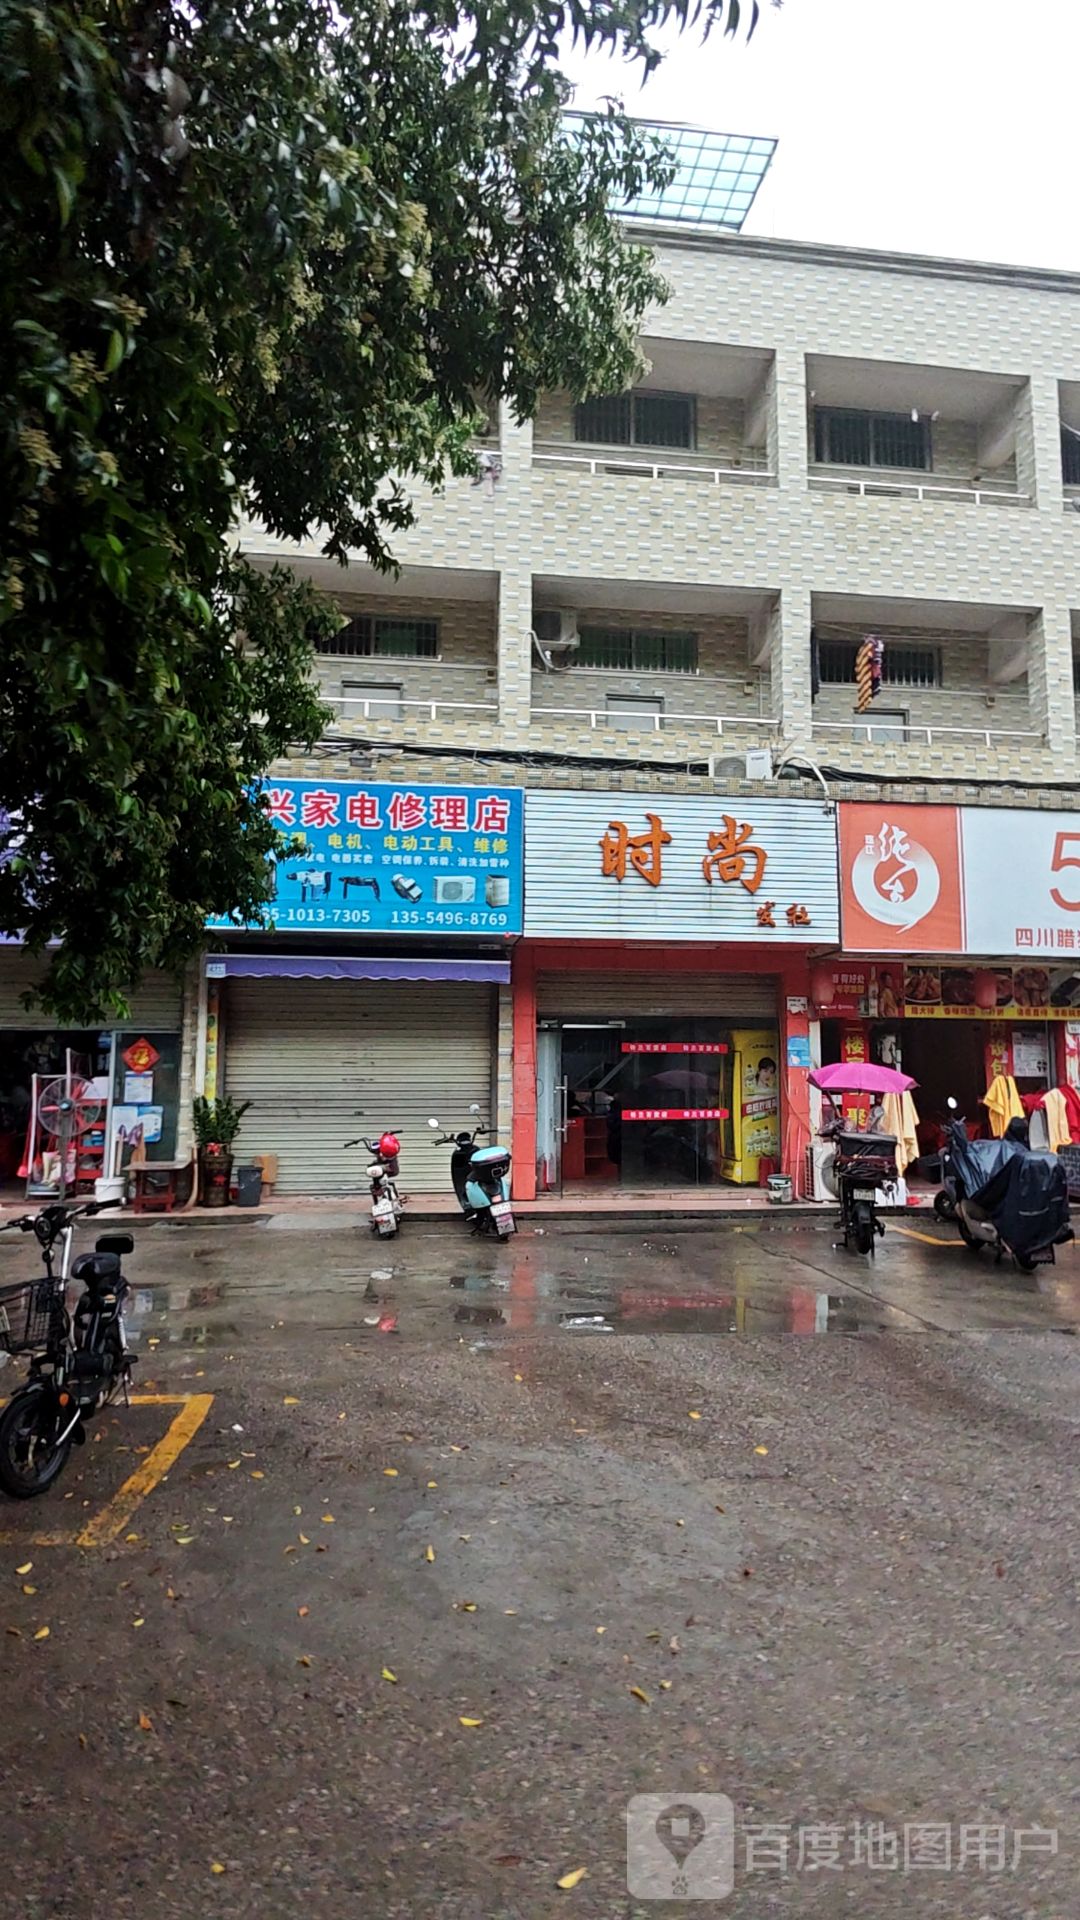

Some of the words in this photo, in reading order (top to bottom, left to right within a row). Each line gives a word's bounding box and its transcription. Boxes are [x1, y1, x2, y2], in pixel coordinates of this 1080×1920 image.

[241, 787, 510, 833] 兴家电修理店
[599, 813, 767, 894] 时尚
[261, 908, 371, 922] 35-1013-7305
[391, 911, 508, 926] 135-5496-8769
[1015, 927, 1080, 949] 四川腊
